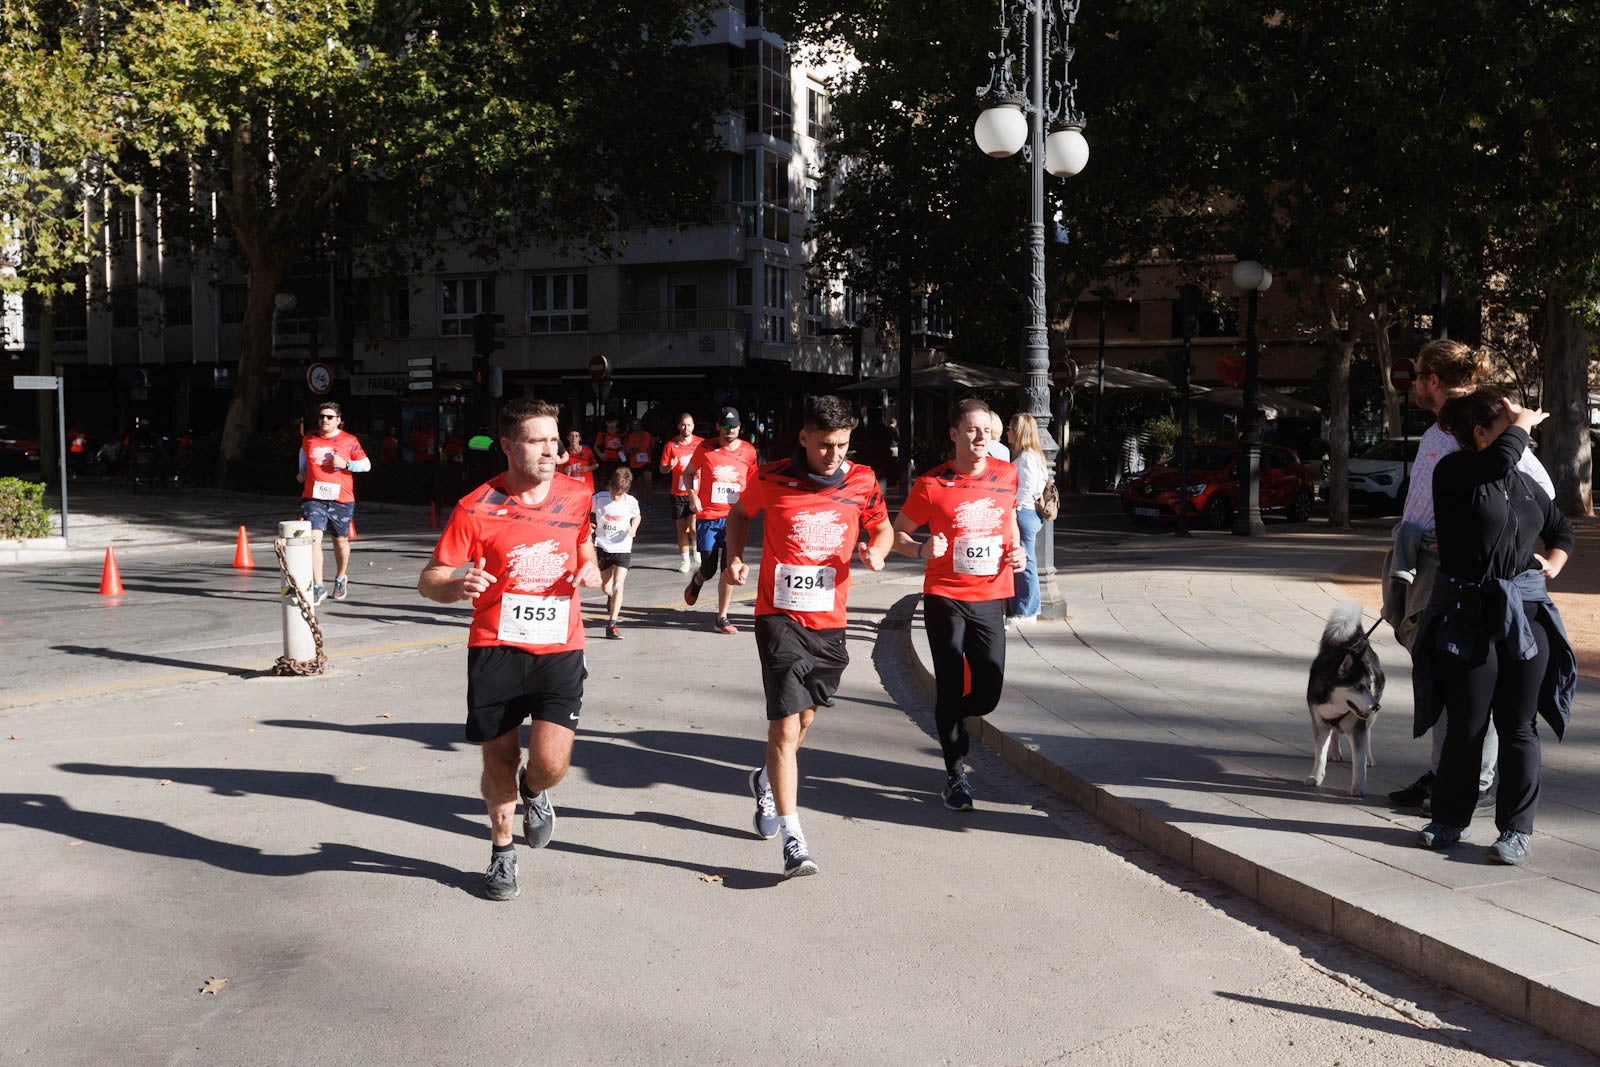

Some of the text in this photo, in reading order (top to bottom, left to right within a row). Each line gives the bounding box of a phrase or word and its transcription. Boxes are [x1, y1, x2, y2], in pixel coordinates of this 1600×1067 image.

[966, 546, 990, 558] 621
[784, 575, 824, 589] 1294
[513, 605, 556, 621] 1553
